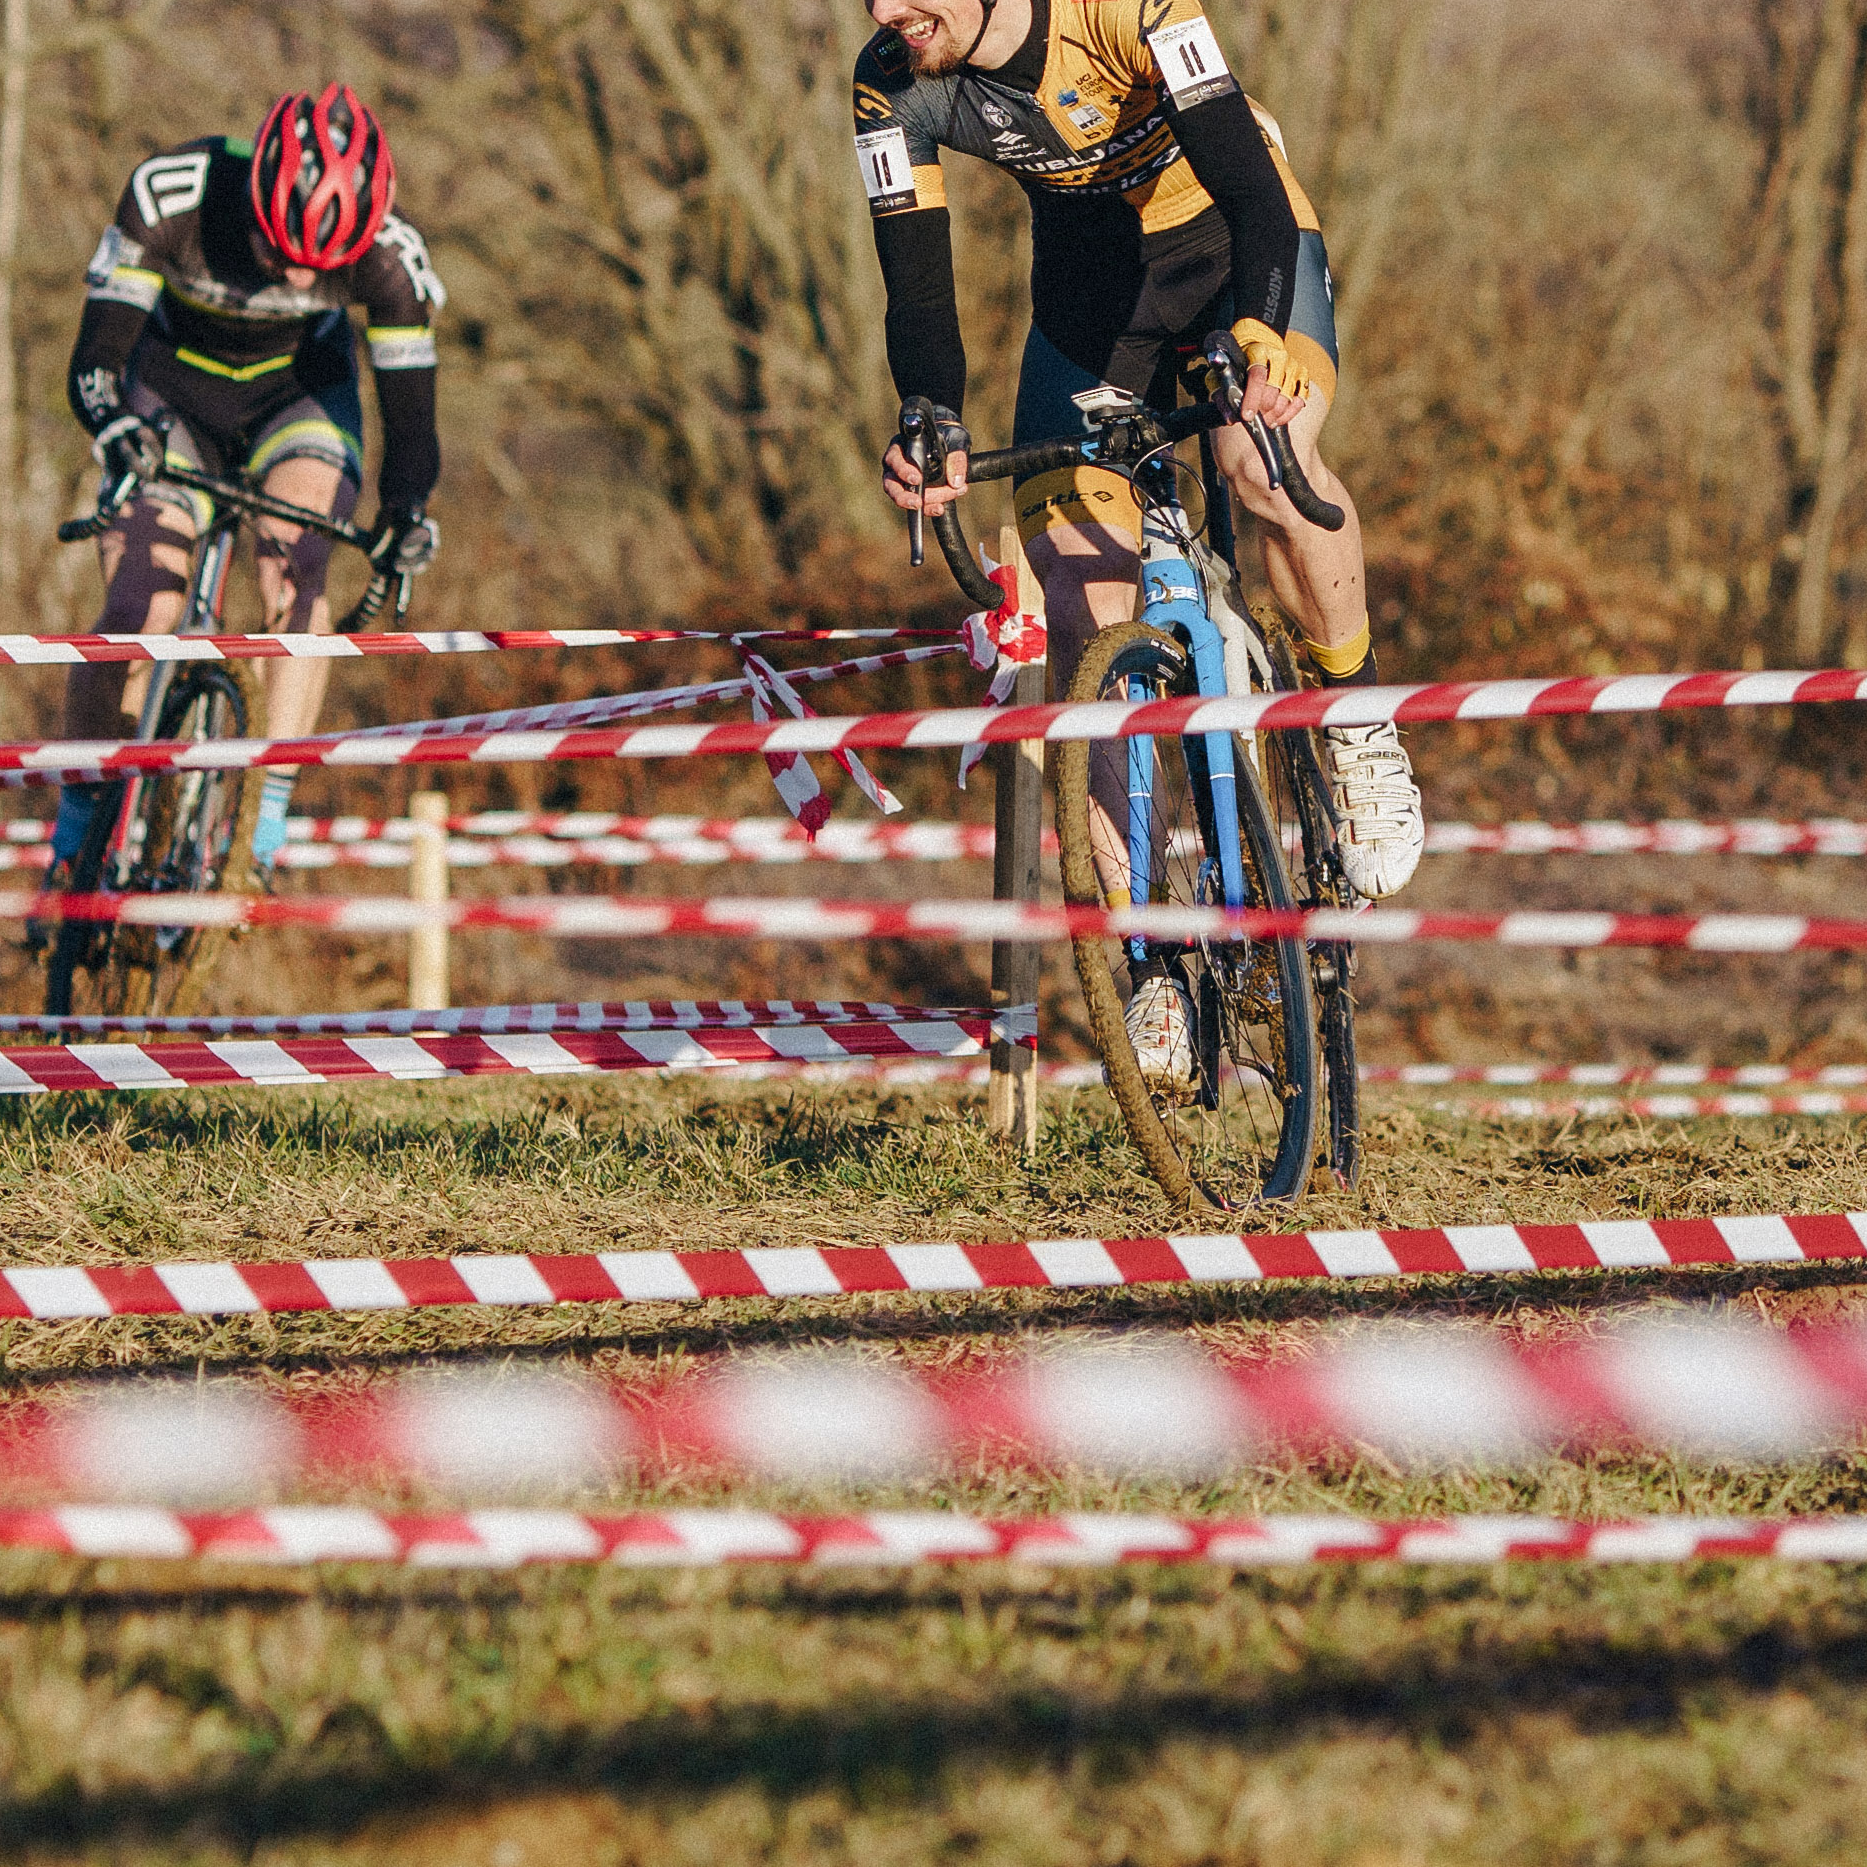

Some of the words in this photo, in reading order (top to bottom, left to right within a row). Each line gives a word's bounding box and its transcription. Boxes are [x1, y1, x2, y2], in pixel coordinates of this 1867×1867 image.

[1178, 40, 1206, 78] 11
[1075, 72, 1092, 86] UCI
[871, 150, 894, 189] 11
